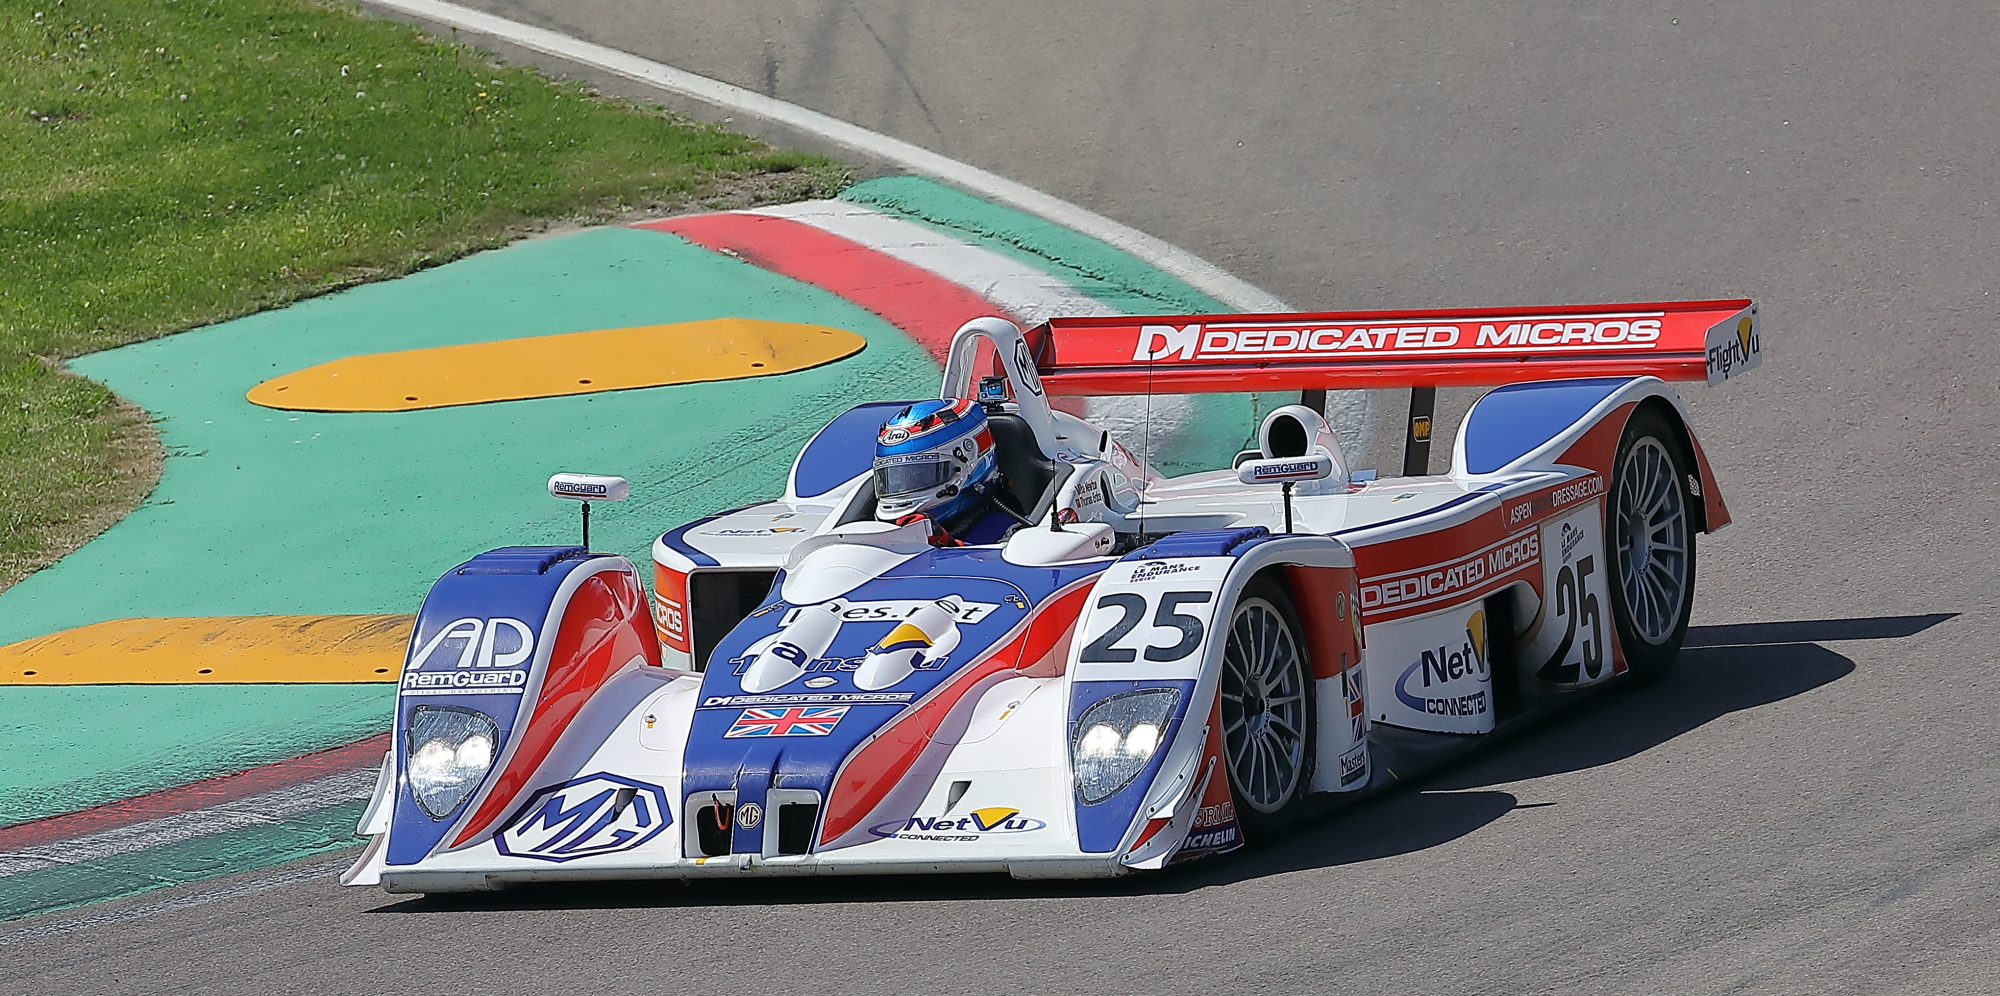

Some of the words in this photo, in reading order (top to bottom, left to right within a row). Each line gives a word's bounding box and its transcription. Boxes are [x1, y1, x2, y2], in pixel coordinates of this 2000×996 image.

[1201, 325, 1460, 353] DEDICATED
[1475, 320, 1663, 346] MICROS
[887, 429, 906, 440] Arai
[1414, 421, 1430, 438] OMP
[905, 454, 940, 462] MICROS
[1131, 566, 1201, 579] ENDURANCE
[1150, 563, 1185, 571] MANS
[1360, 558, 1485, 608] DEDICATED
[1488, 534, 1540, 574] MICROS
[1080, 591, 1213, 663] 25
[1534, 554, 1602, 683] 25
[406, 618, 535, 671] AD
[731, 695, 833, 703] DEDICATED
[1426, 690, 1487, 717] CONNECTED
[904, 809, 1029, 831] NetVu
[899, 834, 980, 842] CONNECTED
[1184, 827, 1236, 849] ICHELIN
